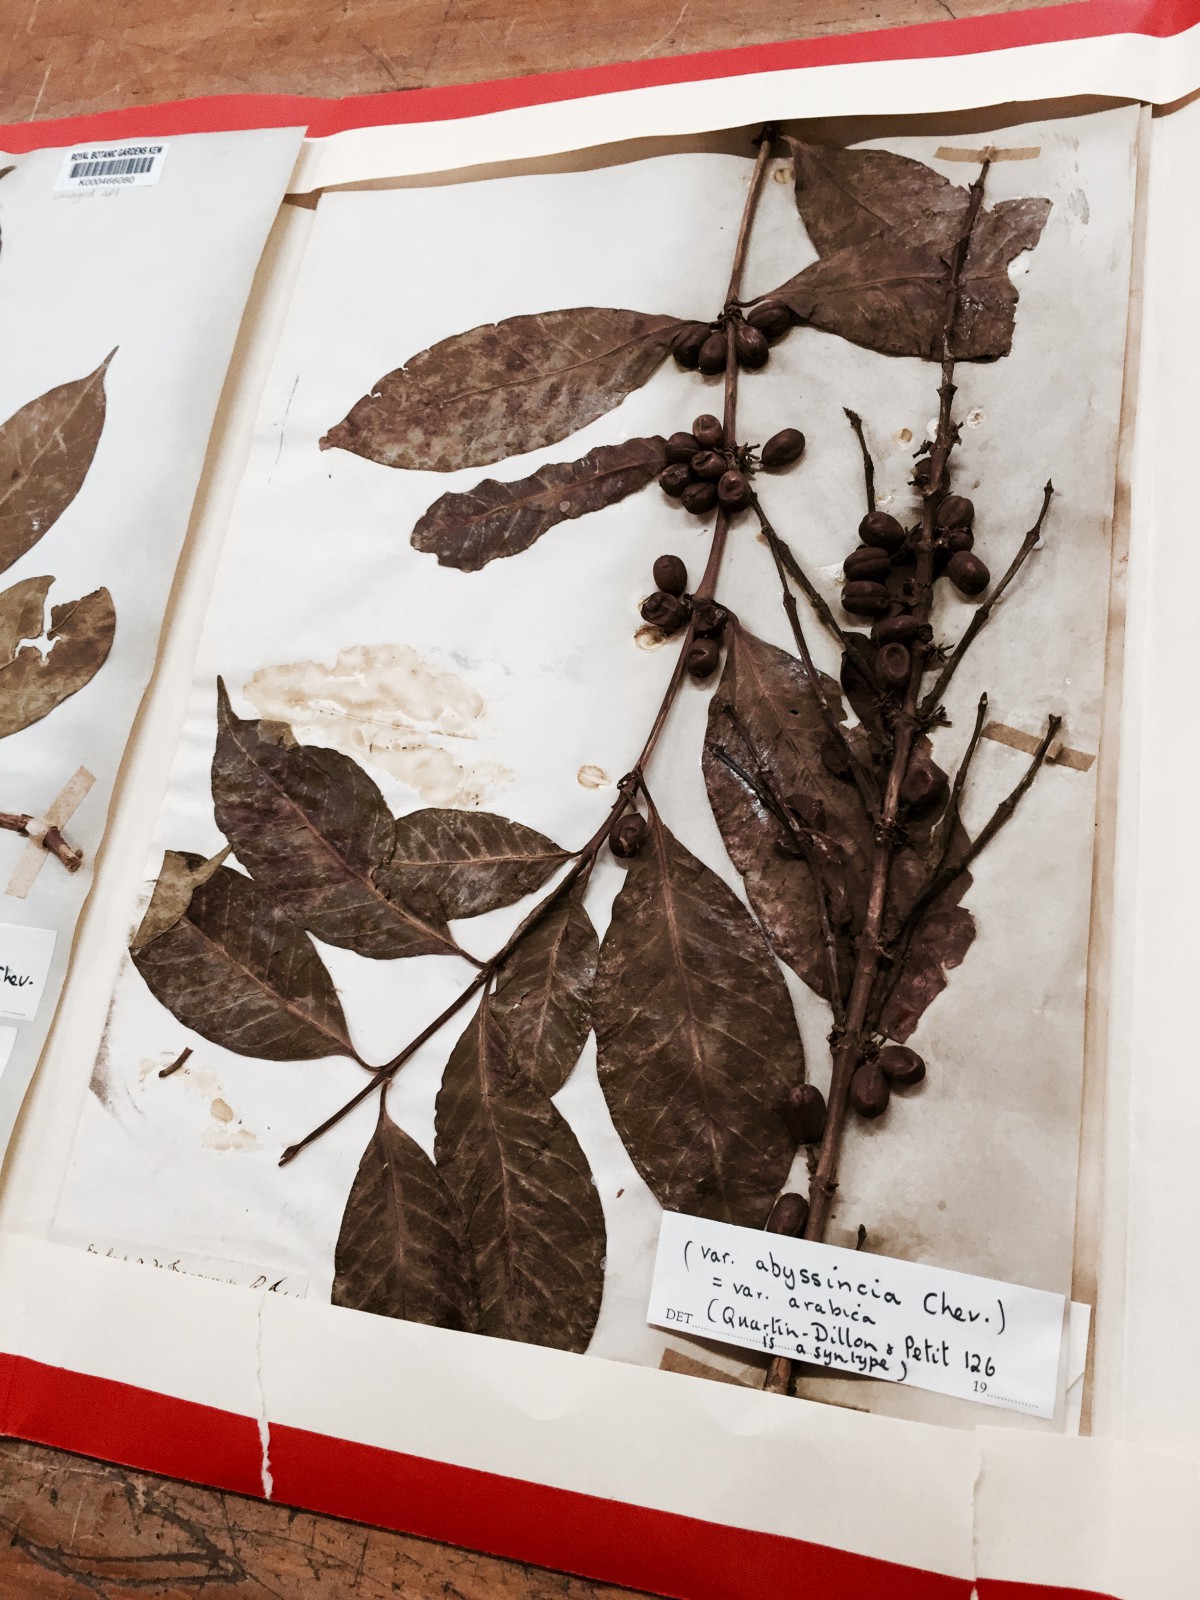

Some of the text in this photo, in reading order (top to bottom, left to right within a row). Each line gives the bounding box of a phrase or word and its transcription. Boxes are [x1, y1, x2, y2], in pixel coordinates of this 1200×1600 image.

[91, 150, 117, 159] BOTANIC
[118, 147, 147, 156] GARDENS
[148, 146, 162, 154] KEW
[733, 1282, 769, 1300] var.
[788, 1296, 877, 1326] arabica
[756, 1251, 901, 1306] abyssincia
[923, 1292, 1007, 1336] Chev.)
[665, 1307, 694, 1325] DET
[763, 1333, 775, 1350] is
[796, 1343, 806, 1355] a
[904, 1335, 950, 1368] Petit
[965, 1351, 997, 1377] 126
[973, 1380, 988, 1394] 19
